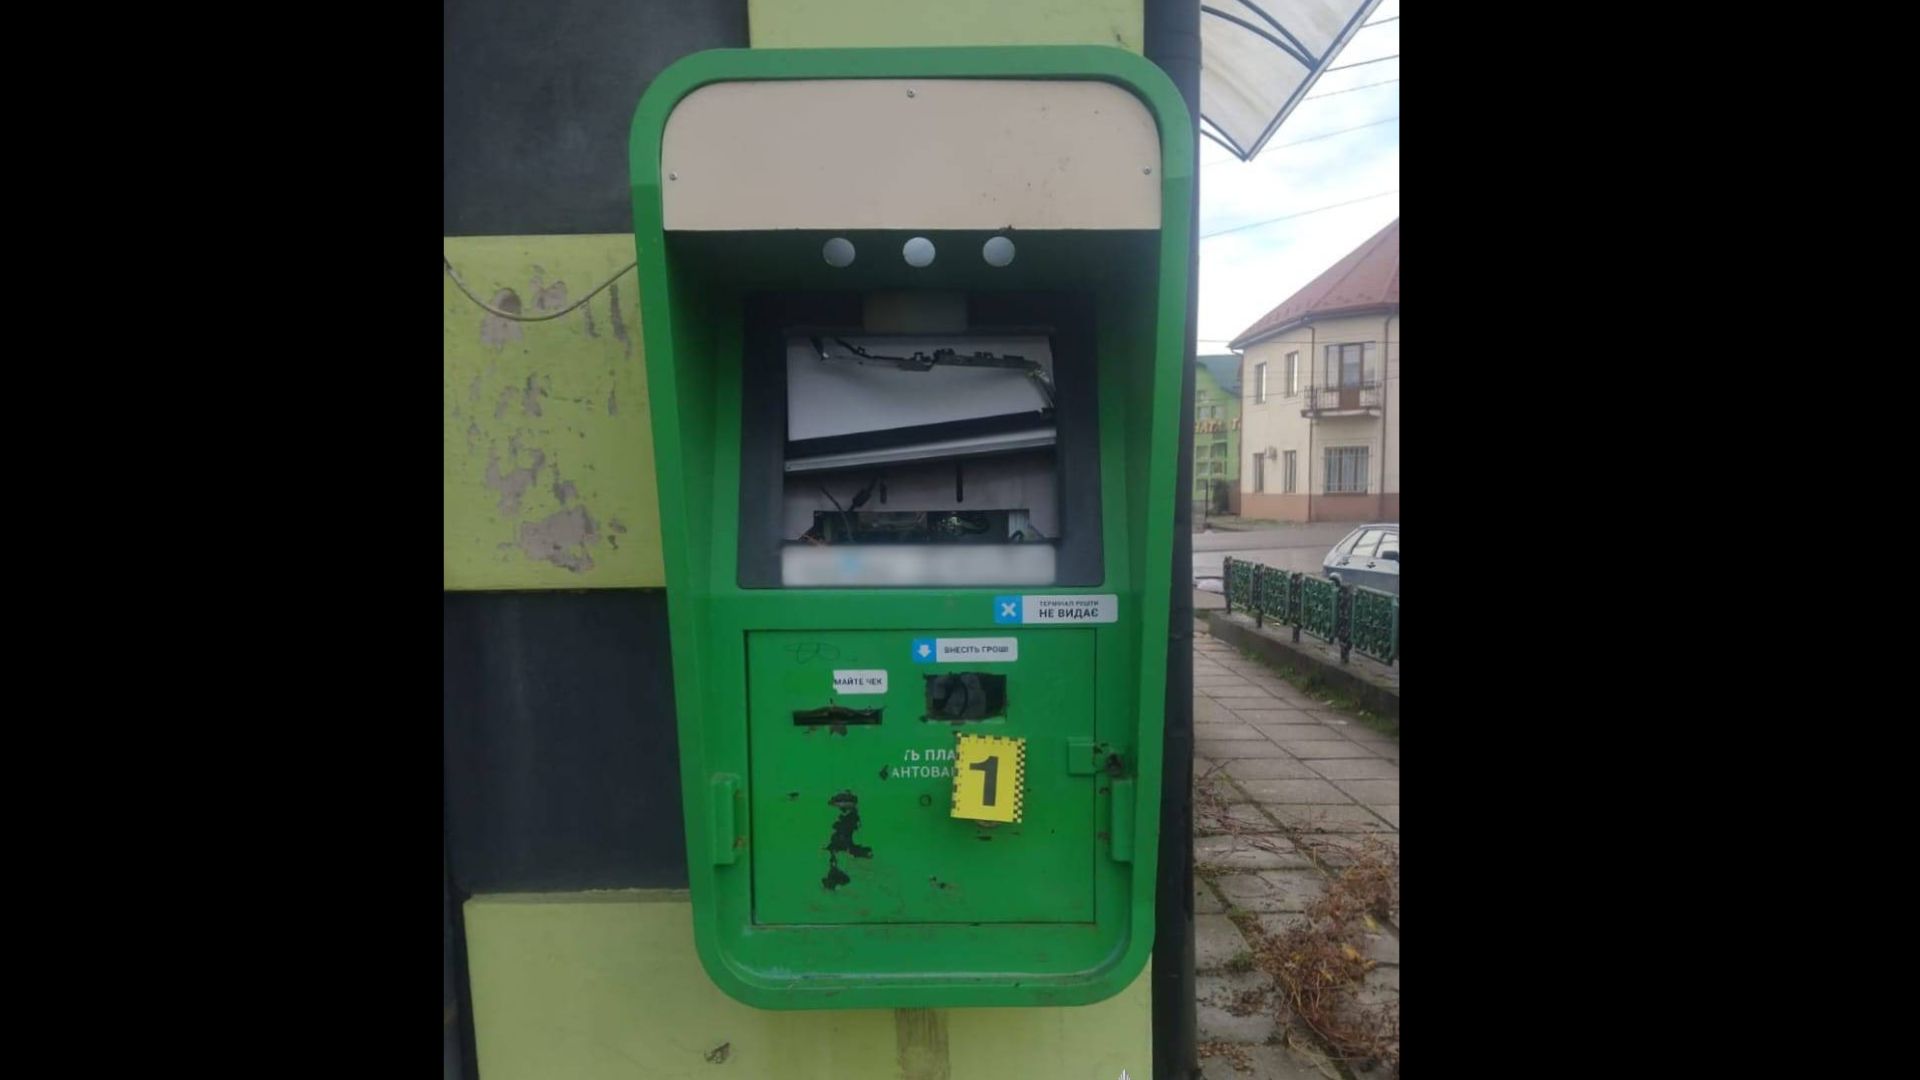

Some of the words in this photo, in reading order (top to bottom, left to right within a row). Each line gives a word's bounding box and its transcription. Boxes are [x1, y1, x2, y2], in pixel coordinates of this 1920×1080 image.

[1039, 608, 1055, 618] НЕ
[1057, 607, 1099, 619] ВИДАЄ
[944, 645, 980, 654] ВНЕСІТЬ
[969, 755, 999, 807] 1
